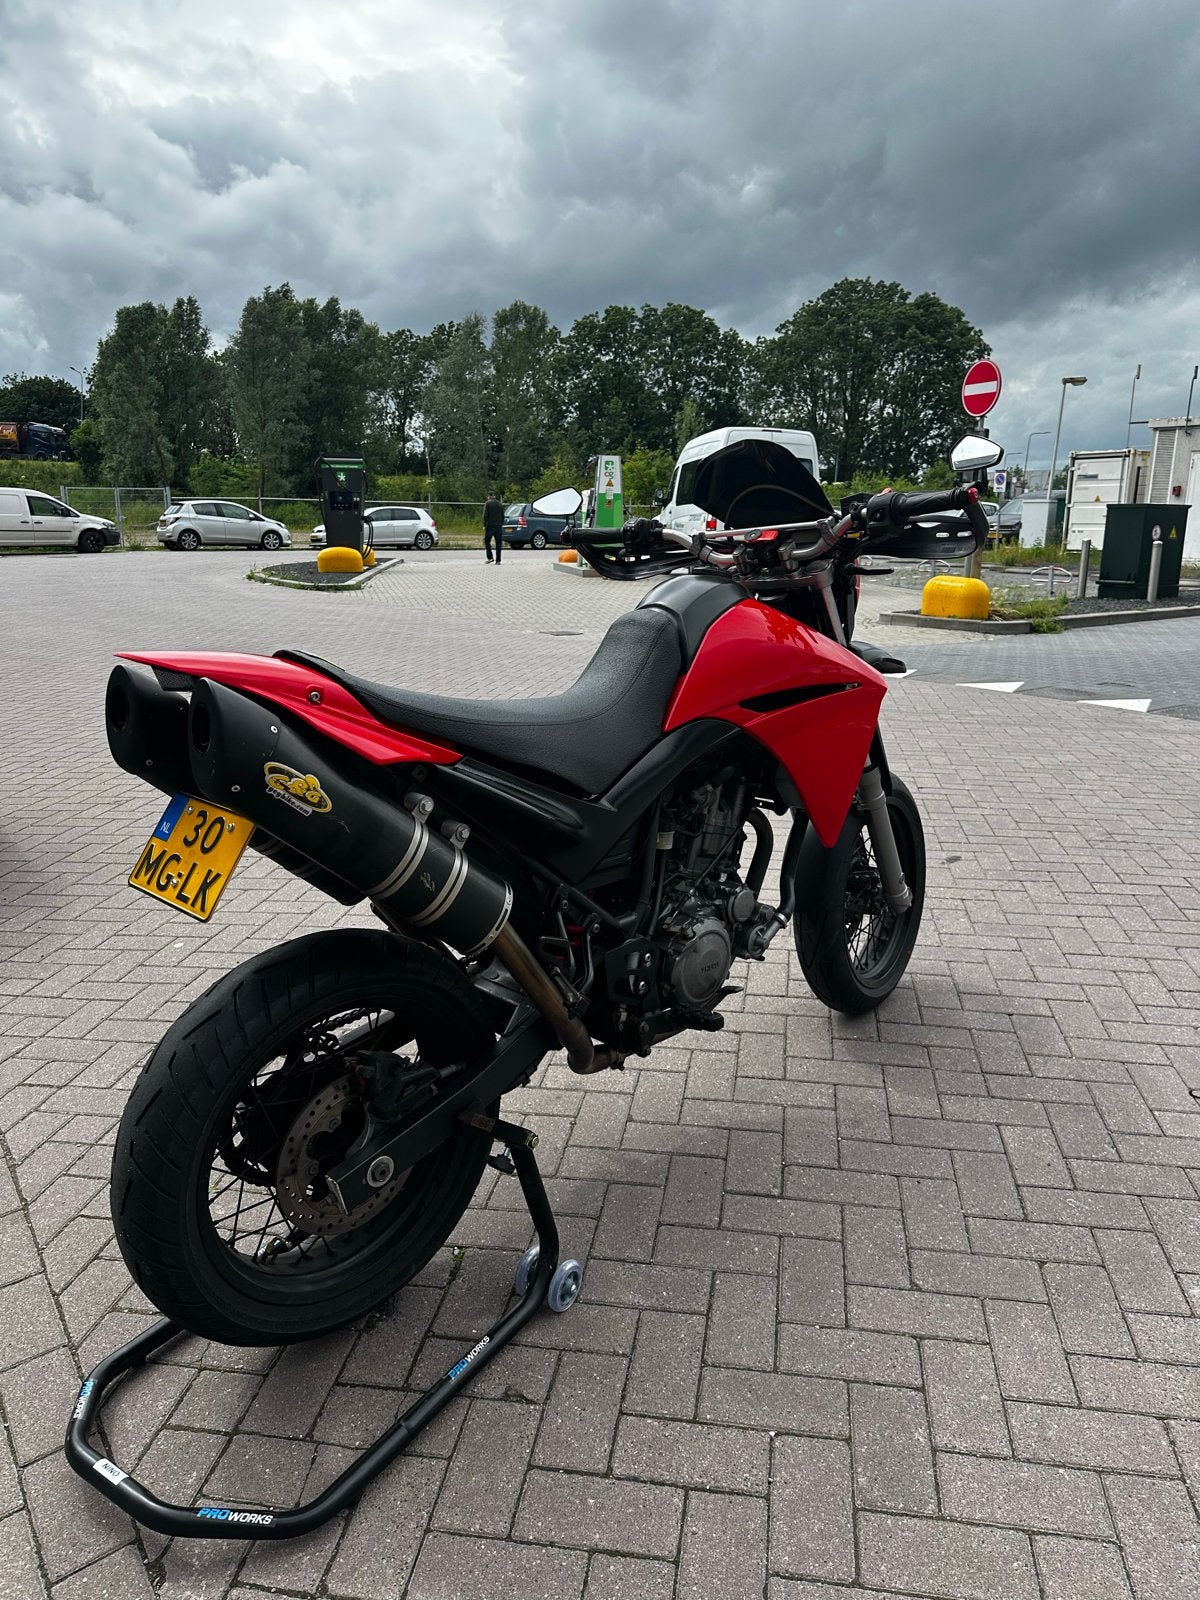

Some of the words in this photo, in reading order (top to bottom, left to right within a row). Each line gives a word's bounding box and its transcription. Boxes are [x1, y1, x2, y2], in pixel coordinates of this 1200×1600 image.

[160, 821, 171, 834] NL
[182, 809, 226, 855] 30
[102, 1463, 120, 1477] NINO
[196, 1507, 274, 1525] PROWORKS
